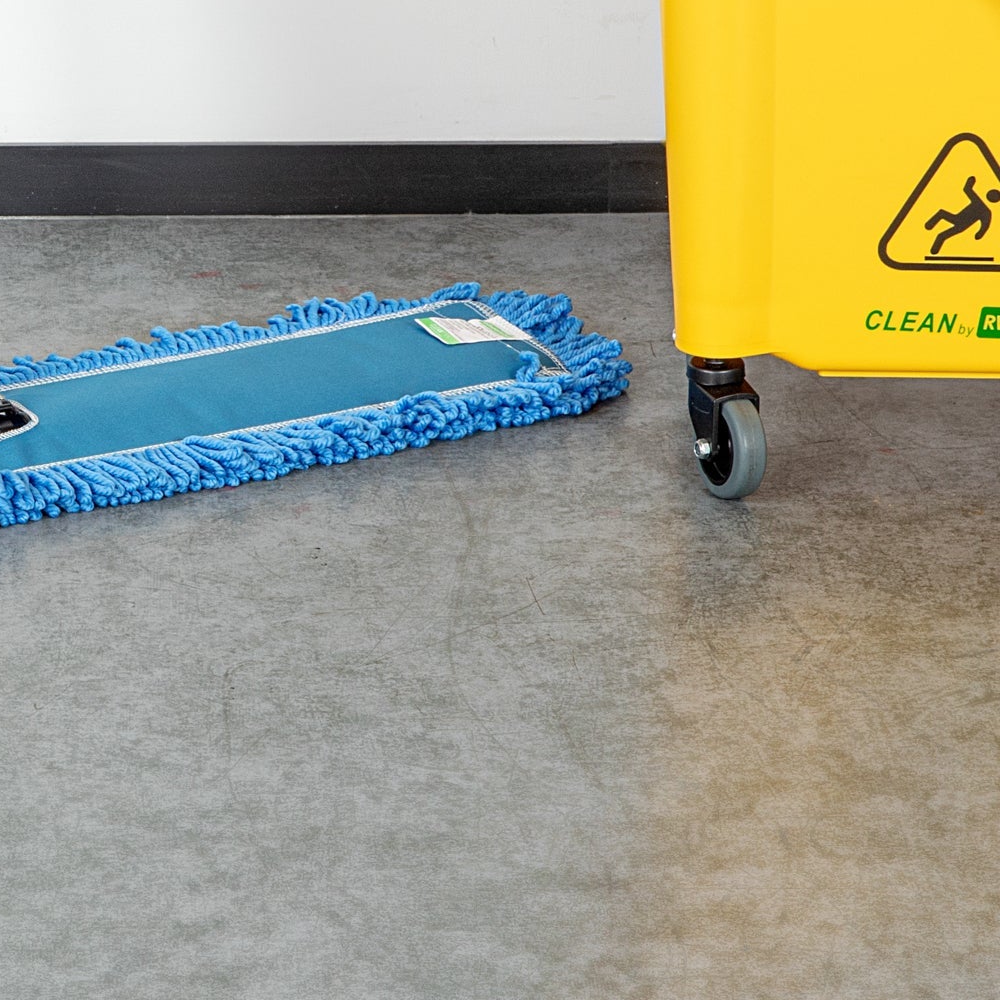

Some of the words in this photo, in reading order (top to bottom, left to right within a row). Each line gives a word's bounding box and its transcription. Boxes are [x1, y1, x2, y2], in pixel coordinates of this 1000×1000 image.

[865, 310, 958, 333] CLEAN
[958, 324, 974, 338] by
[983, 314, 1000, 330] R
